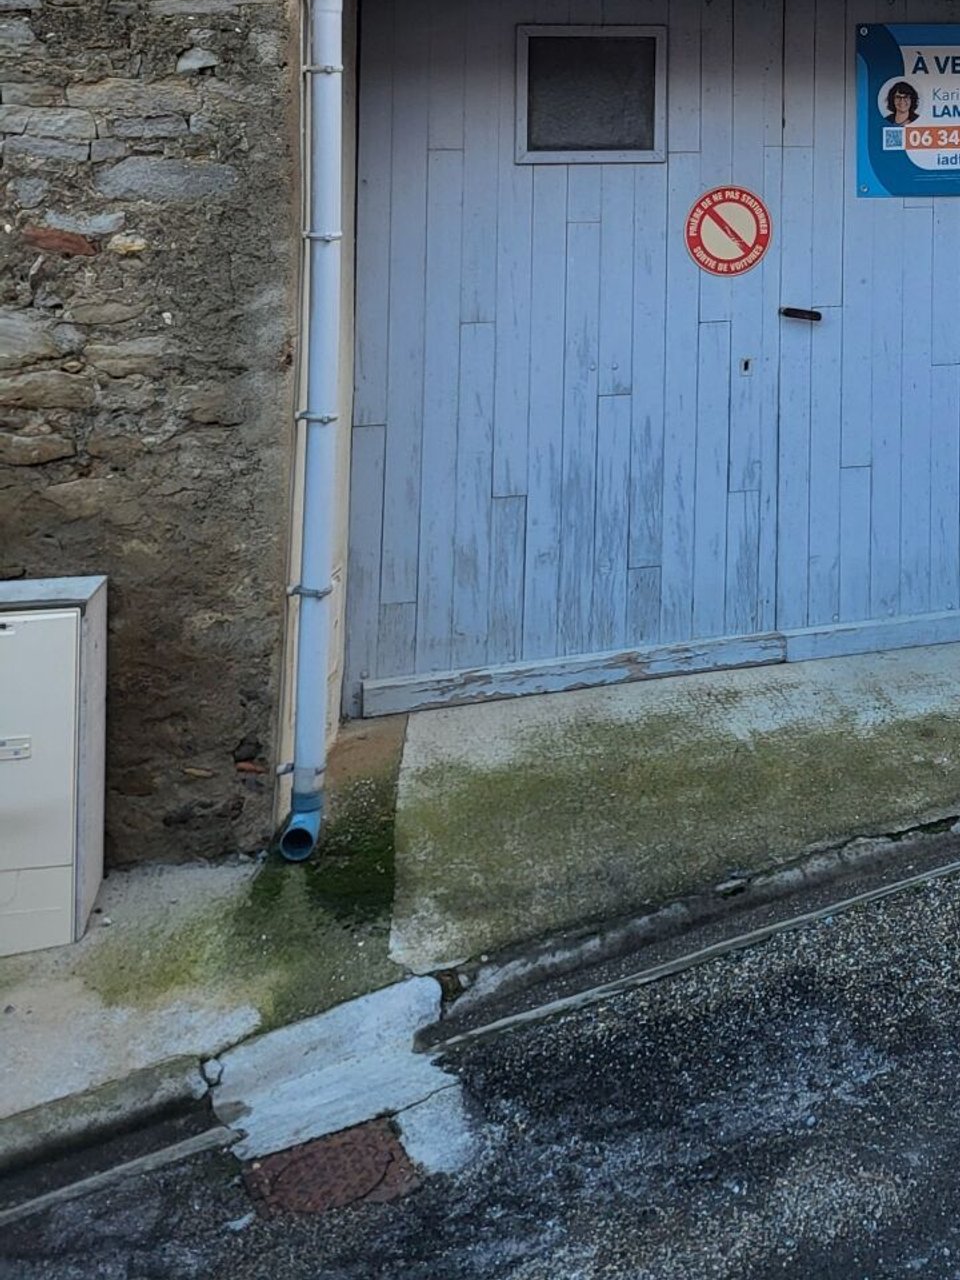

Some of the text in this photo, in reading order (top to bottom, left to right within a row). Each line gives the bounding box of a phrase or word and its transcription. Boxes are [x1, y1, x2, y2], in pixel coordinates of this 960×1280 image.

[912, 51, 929, 74] À
[909, 130, 933, 147] 06
[937, 130, 960, 146] 34
[701, 197, 713, 210] DE
[712, 191, 723, 203] NE
[725, 190, 740, 200] PAS
[693, 245, 764, 272] SORTIE DE VOITURES
